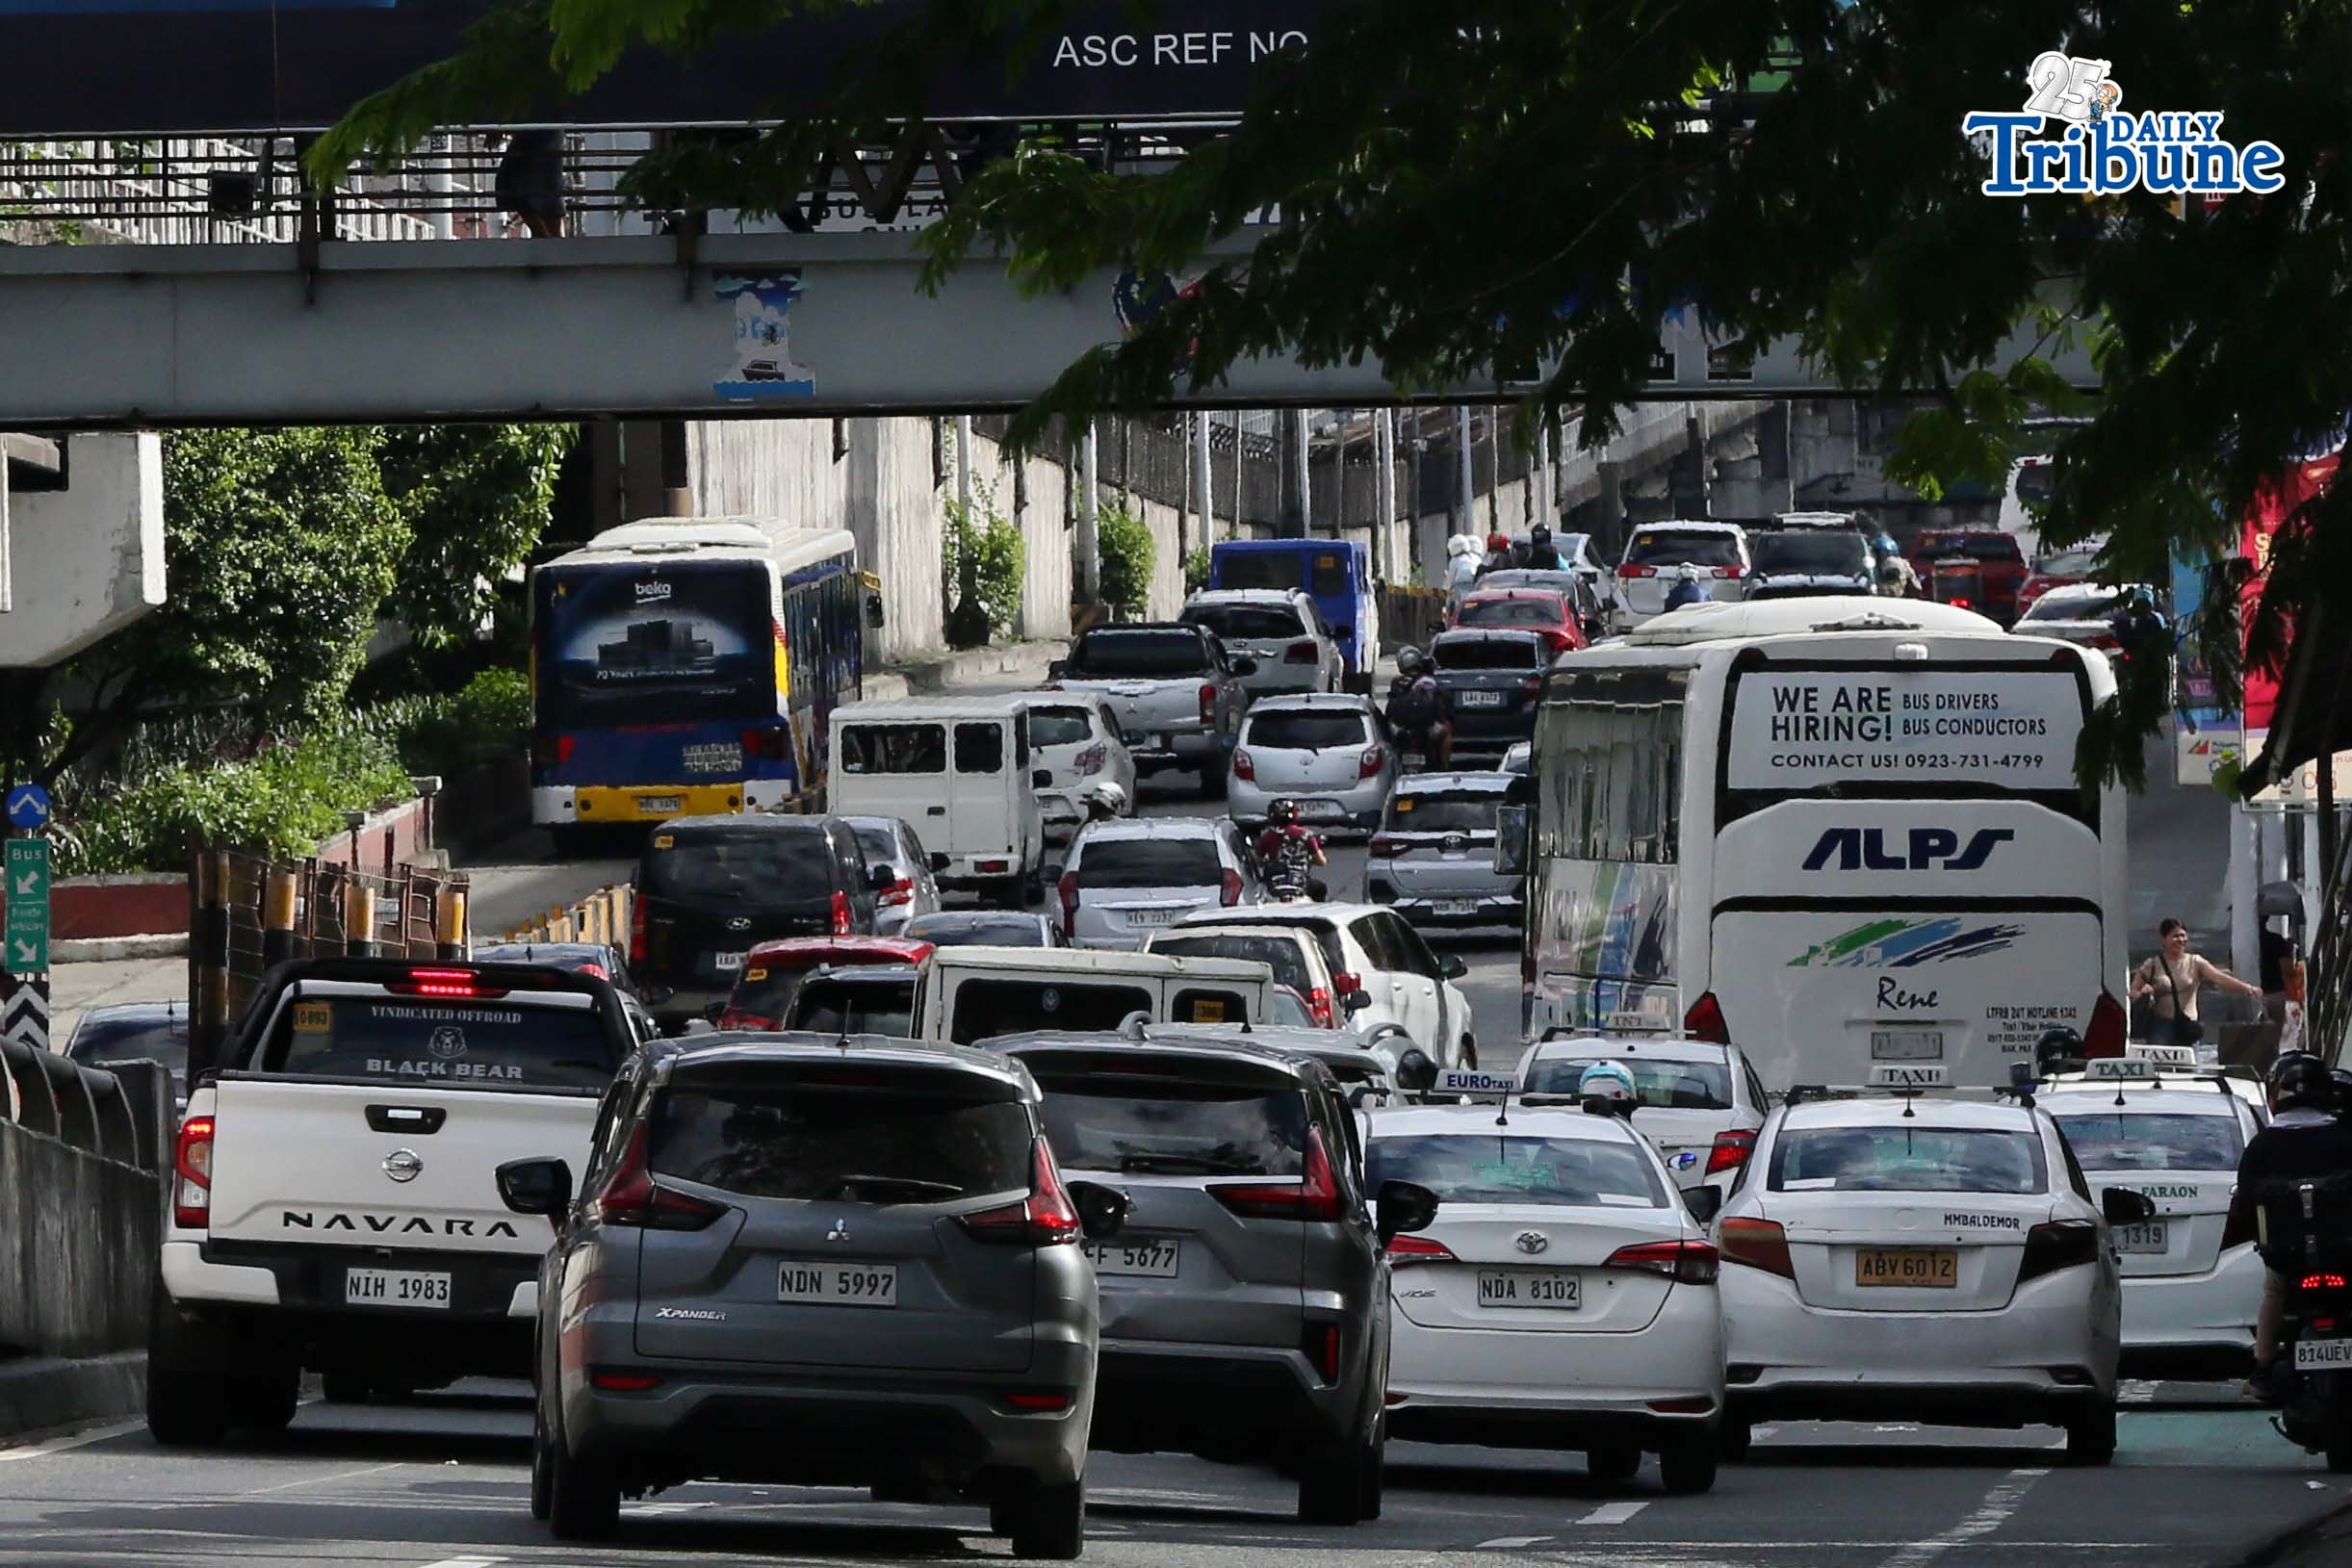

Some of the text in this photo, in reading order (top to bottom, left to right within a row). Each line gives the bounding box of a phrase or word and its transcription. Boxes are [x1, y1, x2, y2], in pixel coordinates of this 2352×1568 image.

[1053, 36, 1138, 66] ASC
[1154, 32, 1233, 64] REF
[634, 582, 671, 596] beko
[1772, 686, 1892, 713] WE ARE
[1902, 693, 1999, 710] BUS DRIVERS
[1771, 715, 1892, 742] HIRING!
[1902, 718, 2047, 735] BUS CONDUCTORS
[1770, 755, 2044, 768] CONTACT US! 0923-731-4799
[1802, 828, 2014, 870] ALPS
[1877, 976, 1938, 1010] Rene
[372, 1006, 522, 1024] VINDICATED OFFROAD
[367, 1059, 523, 1079] BLACK BEAR
[1884, 1069, 1933, 1082] TAXI
[2095, 1063, 2145, 1076] TAXI
[2141, 1186, 2198, 1198] FARAON
[283, 1211, 518, 1238] NAVARA
[2123, 1226, 2162, 1245] 1319
[1124, 1247, 1176, 1268] 5677
[1863, 1257, 1951, 1277] ABV 6012
[349, 1276, 448, 1300] NIH 1983
[780, 1270, 893, 1297] NDN 5997
[1482, 1279, 1578, 1300] NDA 8102
[655, 1307, 726, 1321] XPANDER
